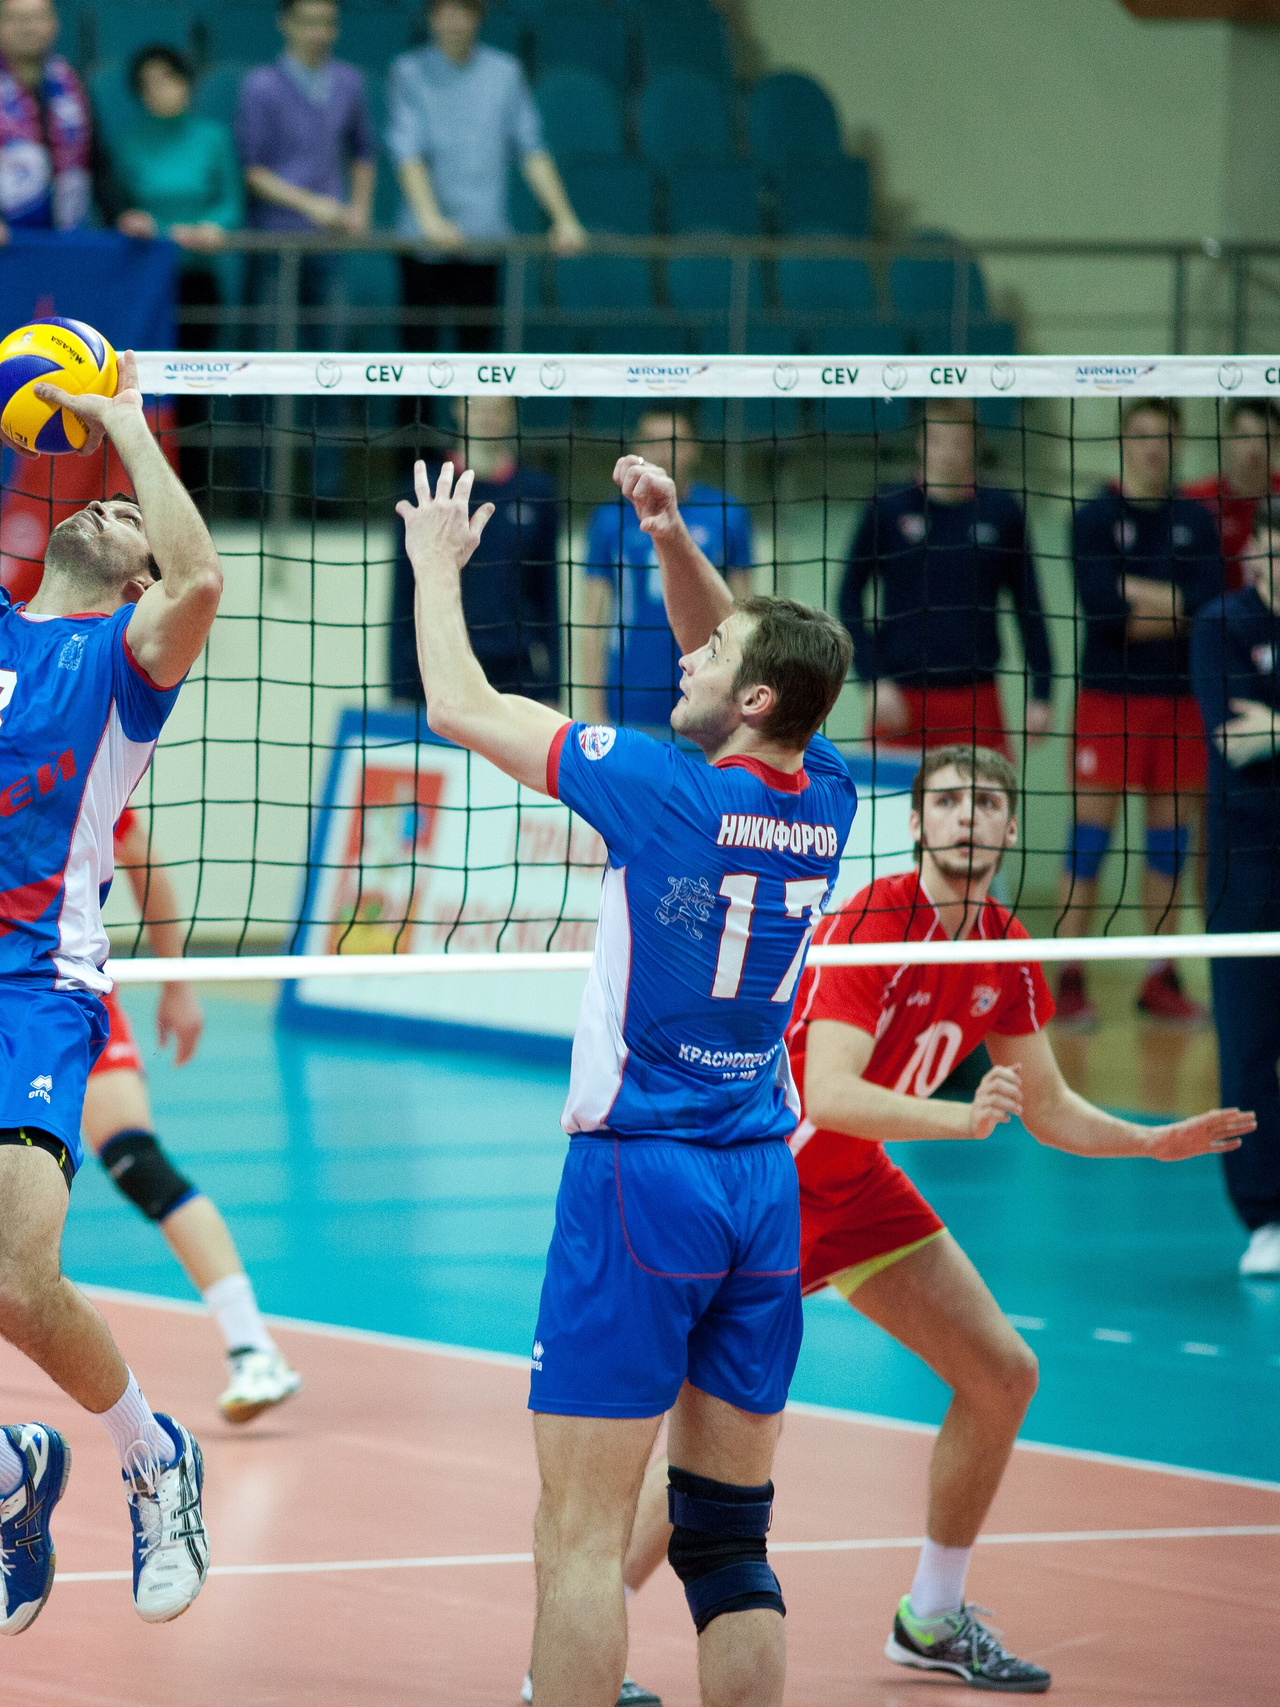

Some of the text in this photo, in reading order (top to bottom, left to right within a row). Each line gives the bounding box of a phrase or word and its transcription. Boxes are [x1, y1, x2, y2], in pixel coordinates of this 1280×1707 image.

[164, 363, 230, 372] AEROFLOT
[365, 365, 404, 382] CEV
[477, 366, 516, 383] CEV
[821, 367, 859, 384] CEV
[930, 367, 967, 384] CEV
[1265, 367, 1280, 384] C
[717, 814, 838, 858] НИКИФОРОВ
[710, 871, 829, 1003] 17
[894, 1019, 963, 1098] 10
